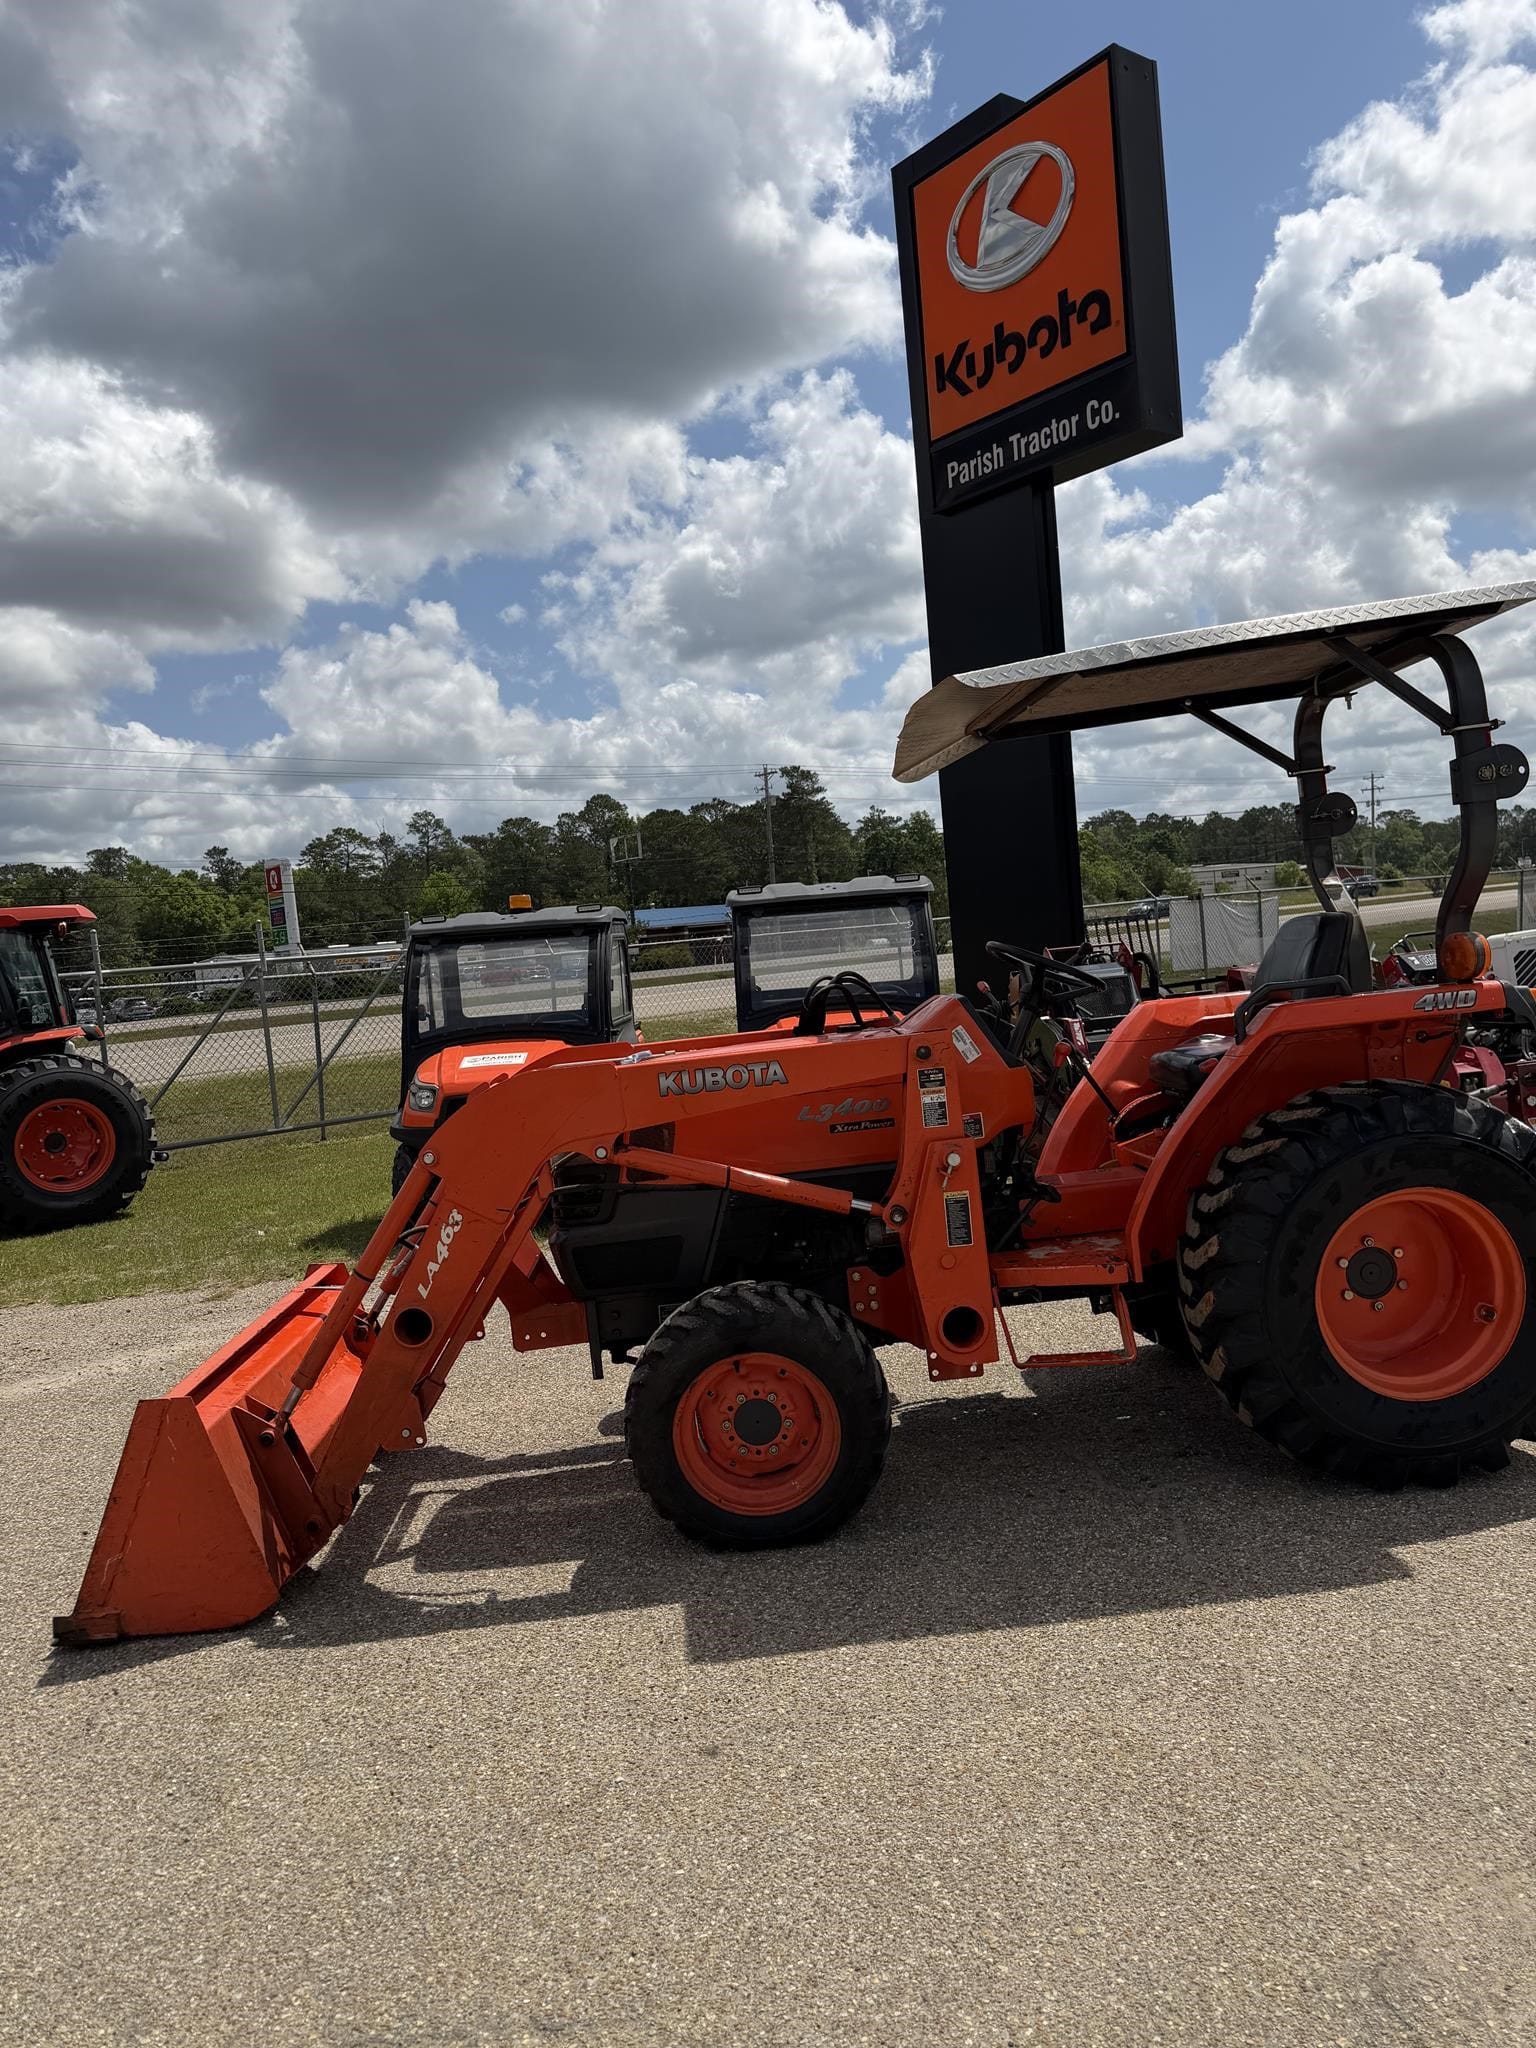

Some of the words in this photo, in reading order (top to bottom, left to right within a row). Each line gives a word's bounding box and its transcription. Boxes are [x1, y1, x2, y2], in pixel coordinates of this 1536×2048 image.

[934, 287, 1112, 397] Kubota
[947, 443, 1004, 489] Parish
[1008, 413, 1079, 462] Tractor
[1086, 399, 1120, 430] Co.
[1414, 989, 1478, 1012] 4WD
[658, 1059, 789, 1098] KUBOTA
[797, 1098, 889, 1122] L3400
[833, 1124, 860, 1134] Xtra
[860, 1120, 893, 1130] Power
[417, 1208, 463, 1300] LA463
